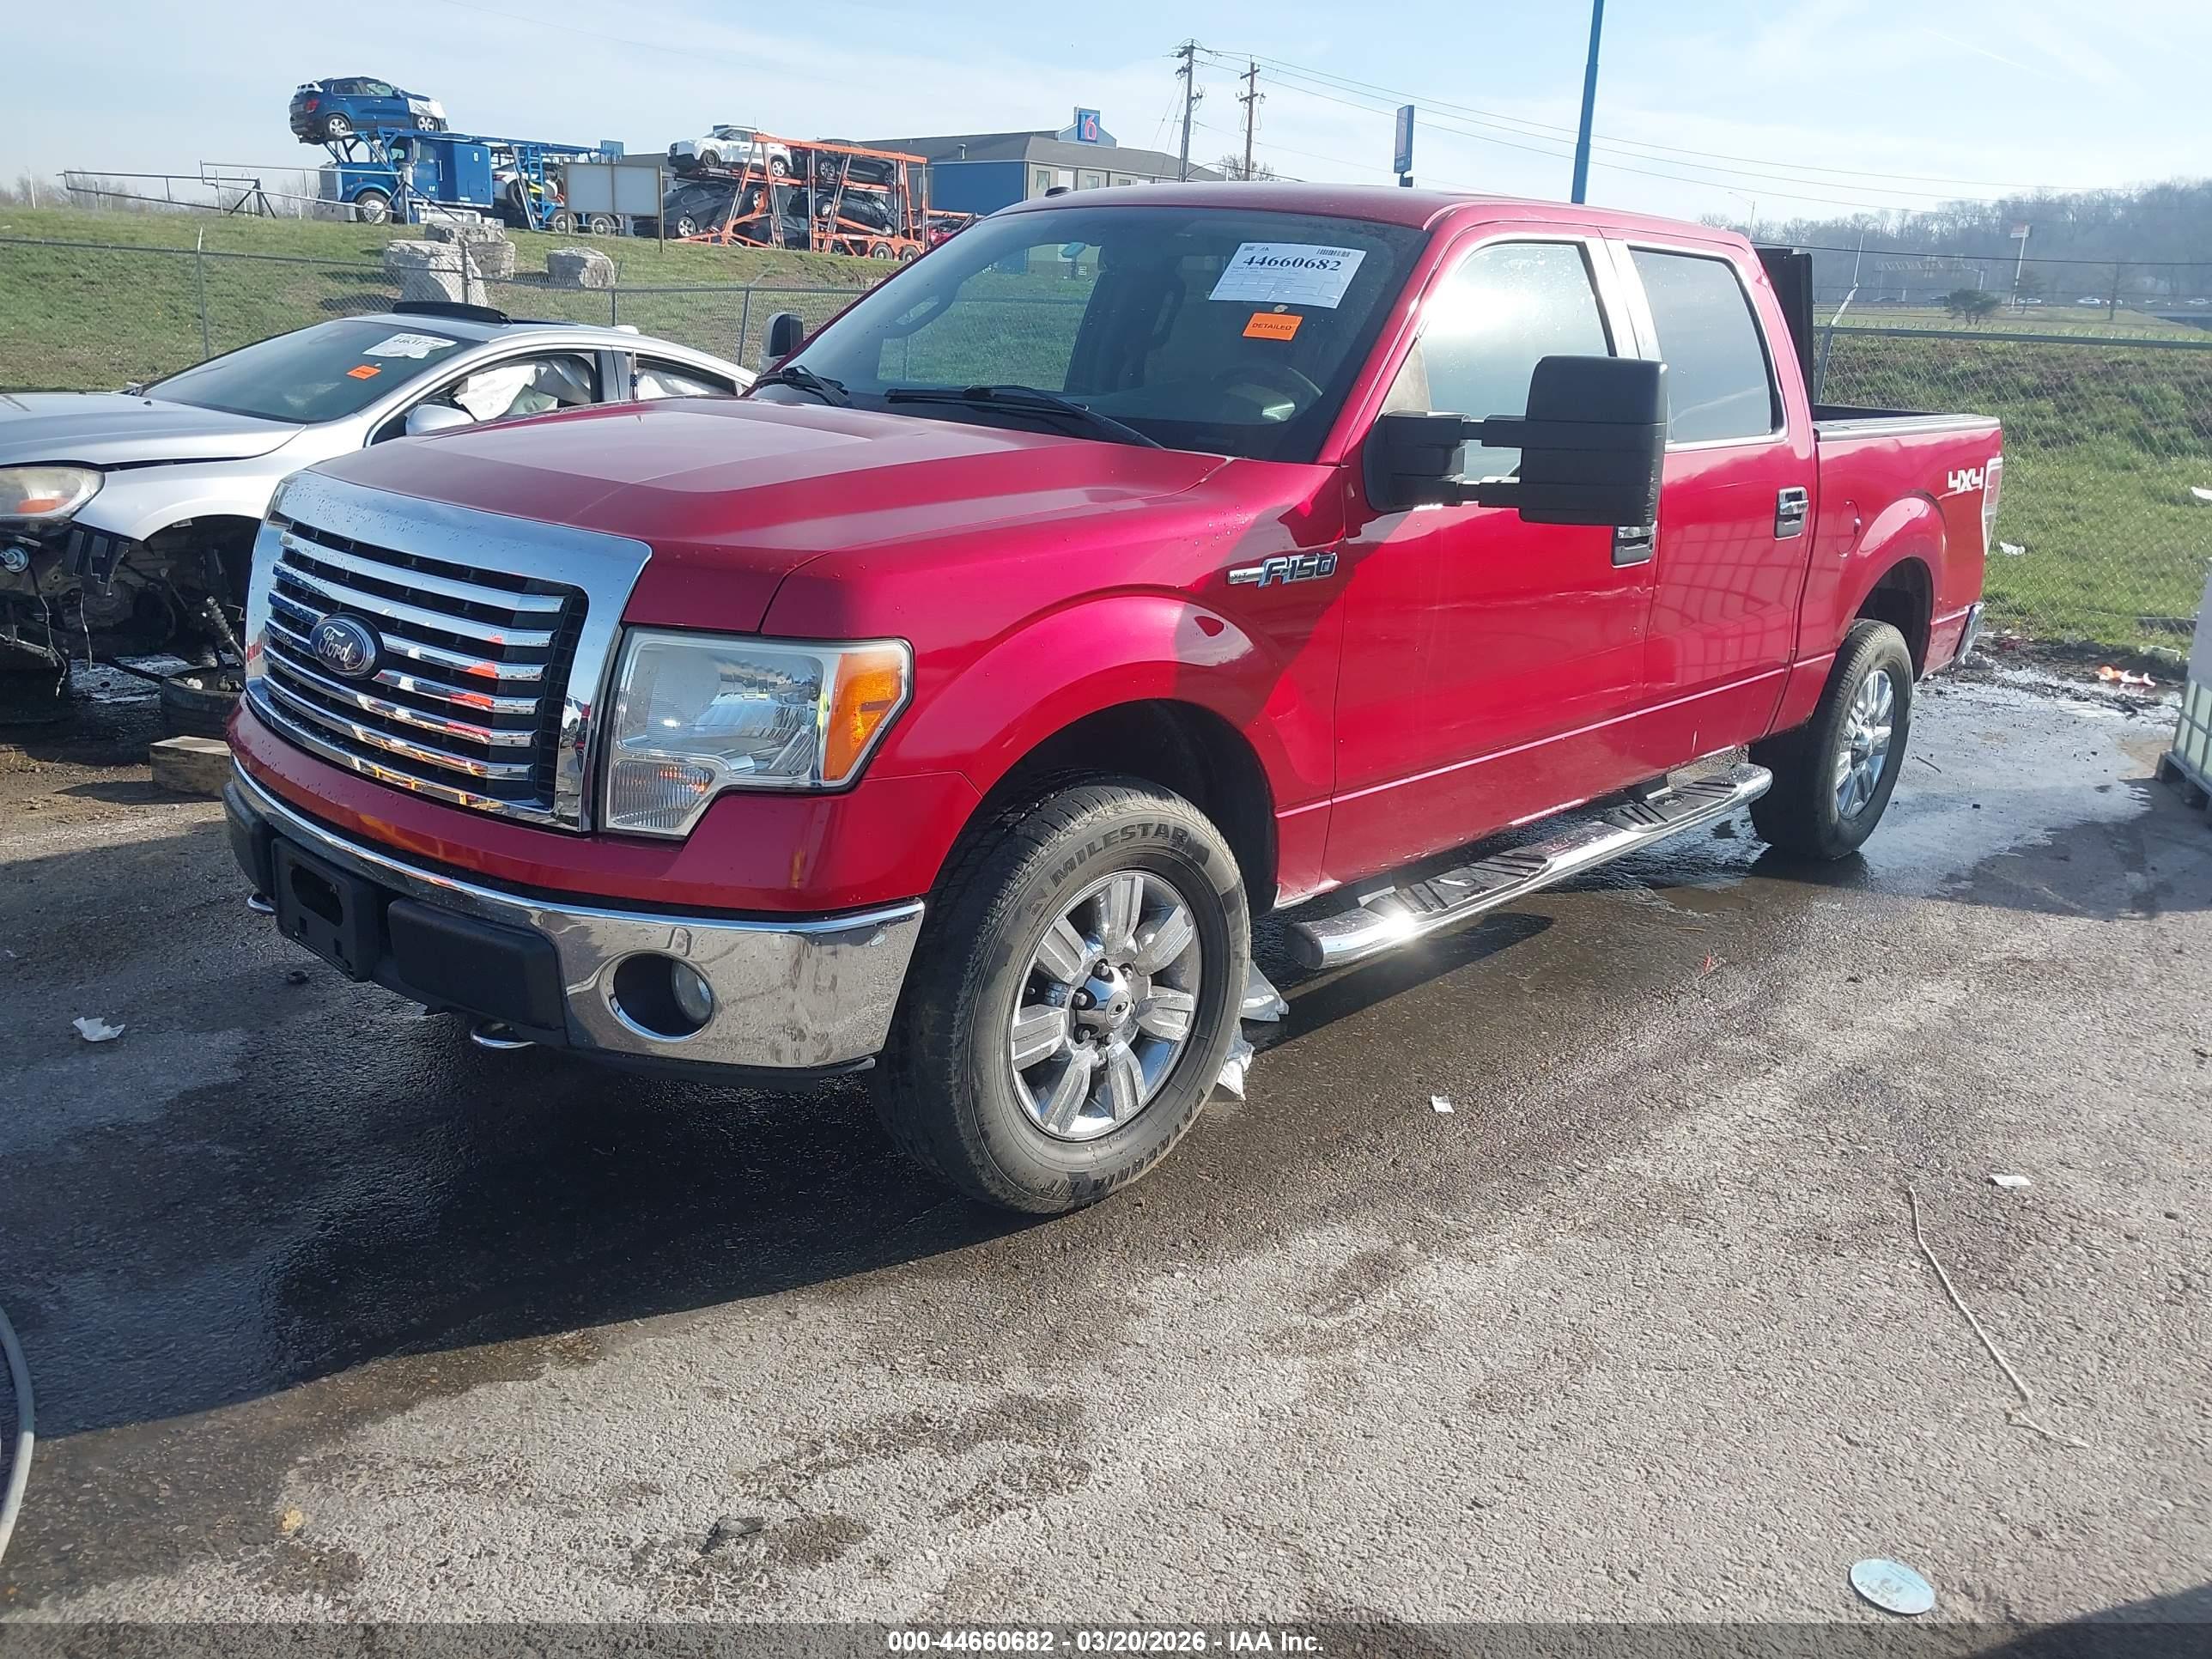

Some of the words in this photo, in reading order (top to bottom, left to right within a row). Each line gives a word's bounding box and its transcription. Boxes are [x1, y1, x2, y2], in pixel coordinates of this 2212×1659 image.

[1085, 114, 1097, 141] 6
[1243, 255, 1341, 271] 44660682
[1252, 322, 1292, 331] DETAILED
[319, 625, 353, 662] Ford
[1049, 822, 1188, 887] MILESTAR
